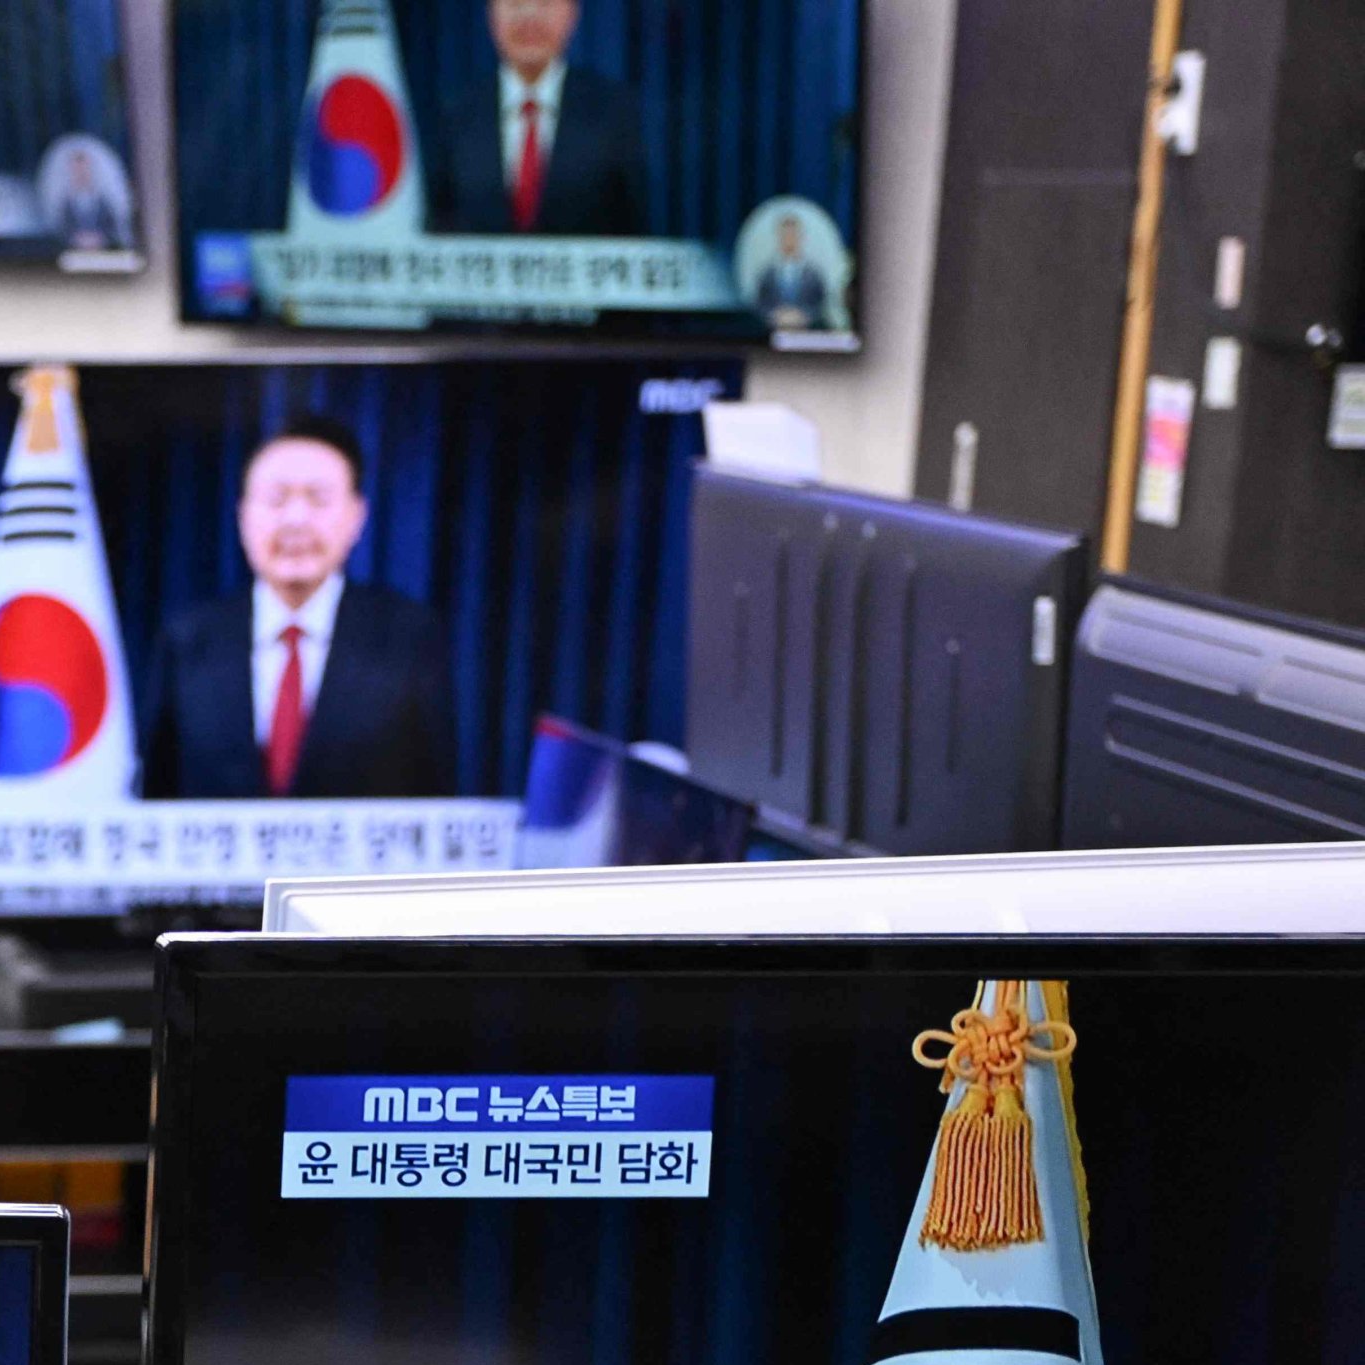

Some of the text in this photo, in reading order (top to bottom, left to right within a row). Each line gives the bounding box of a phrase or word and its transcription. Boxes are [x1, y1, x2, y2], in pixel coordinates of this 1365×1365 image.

[363, 1084, 637, 1123] MBC 뉴스특보
[295, 1141, 698, 1187] 윤 대통령 대국민 담화
